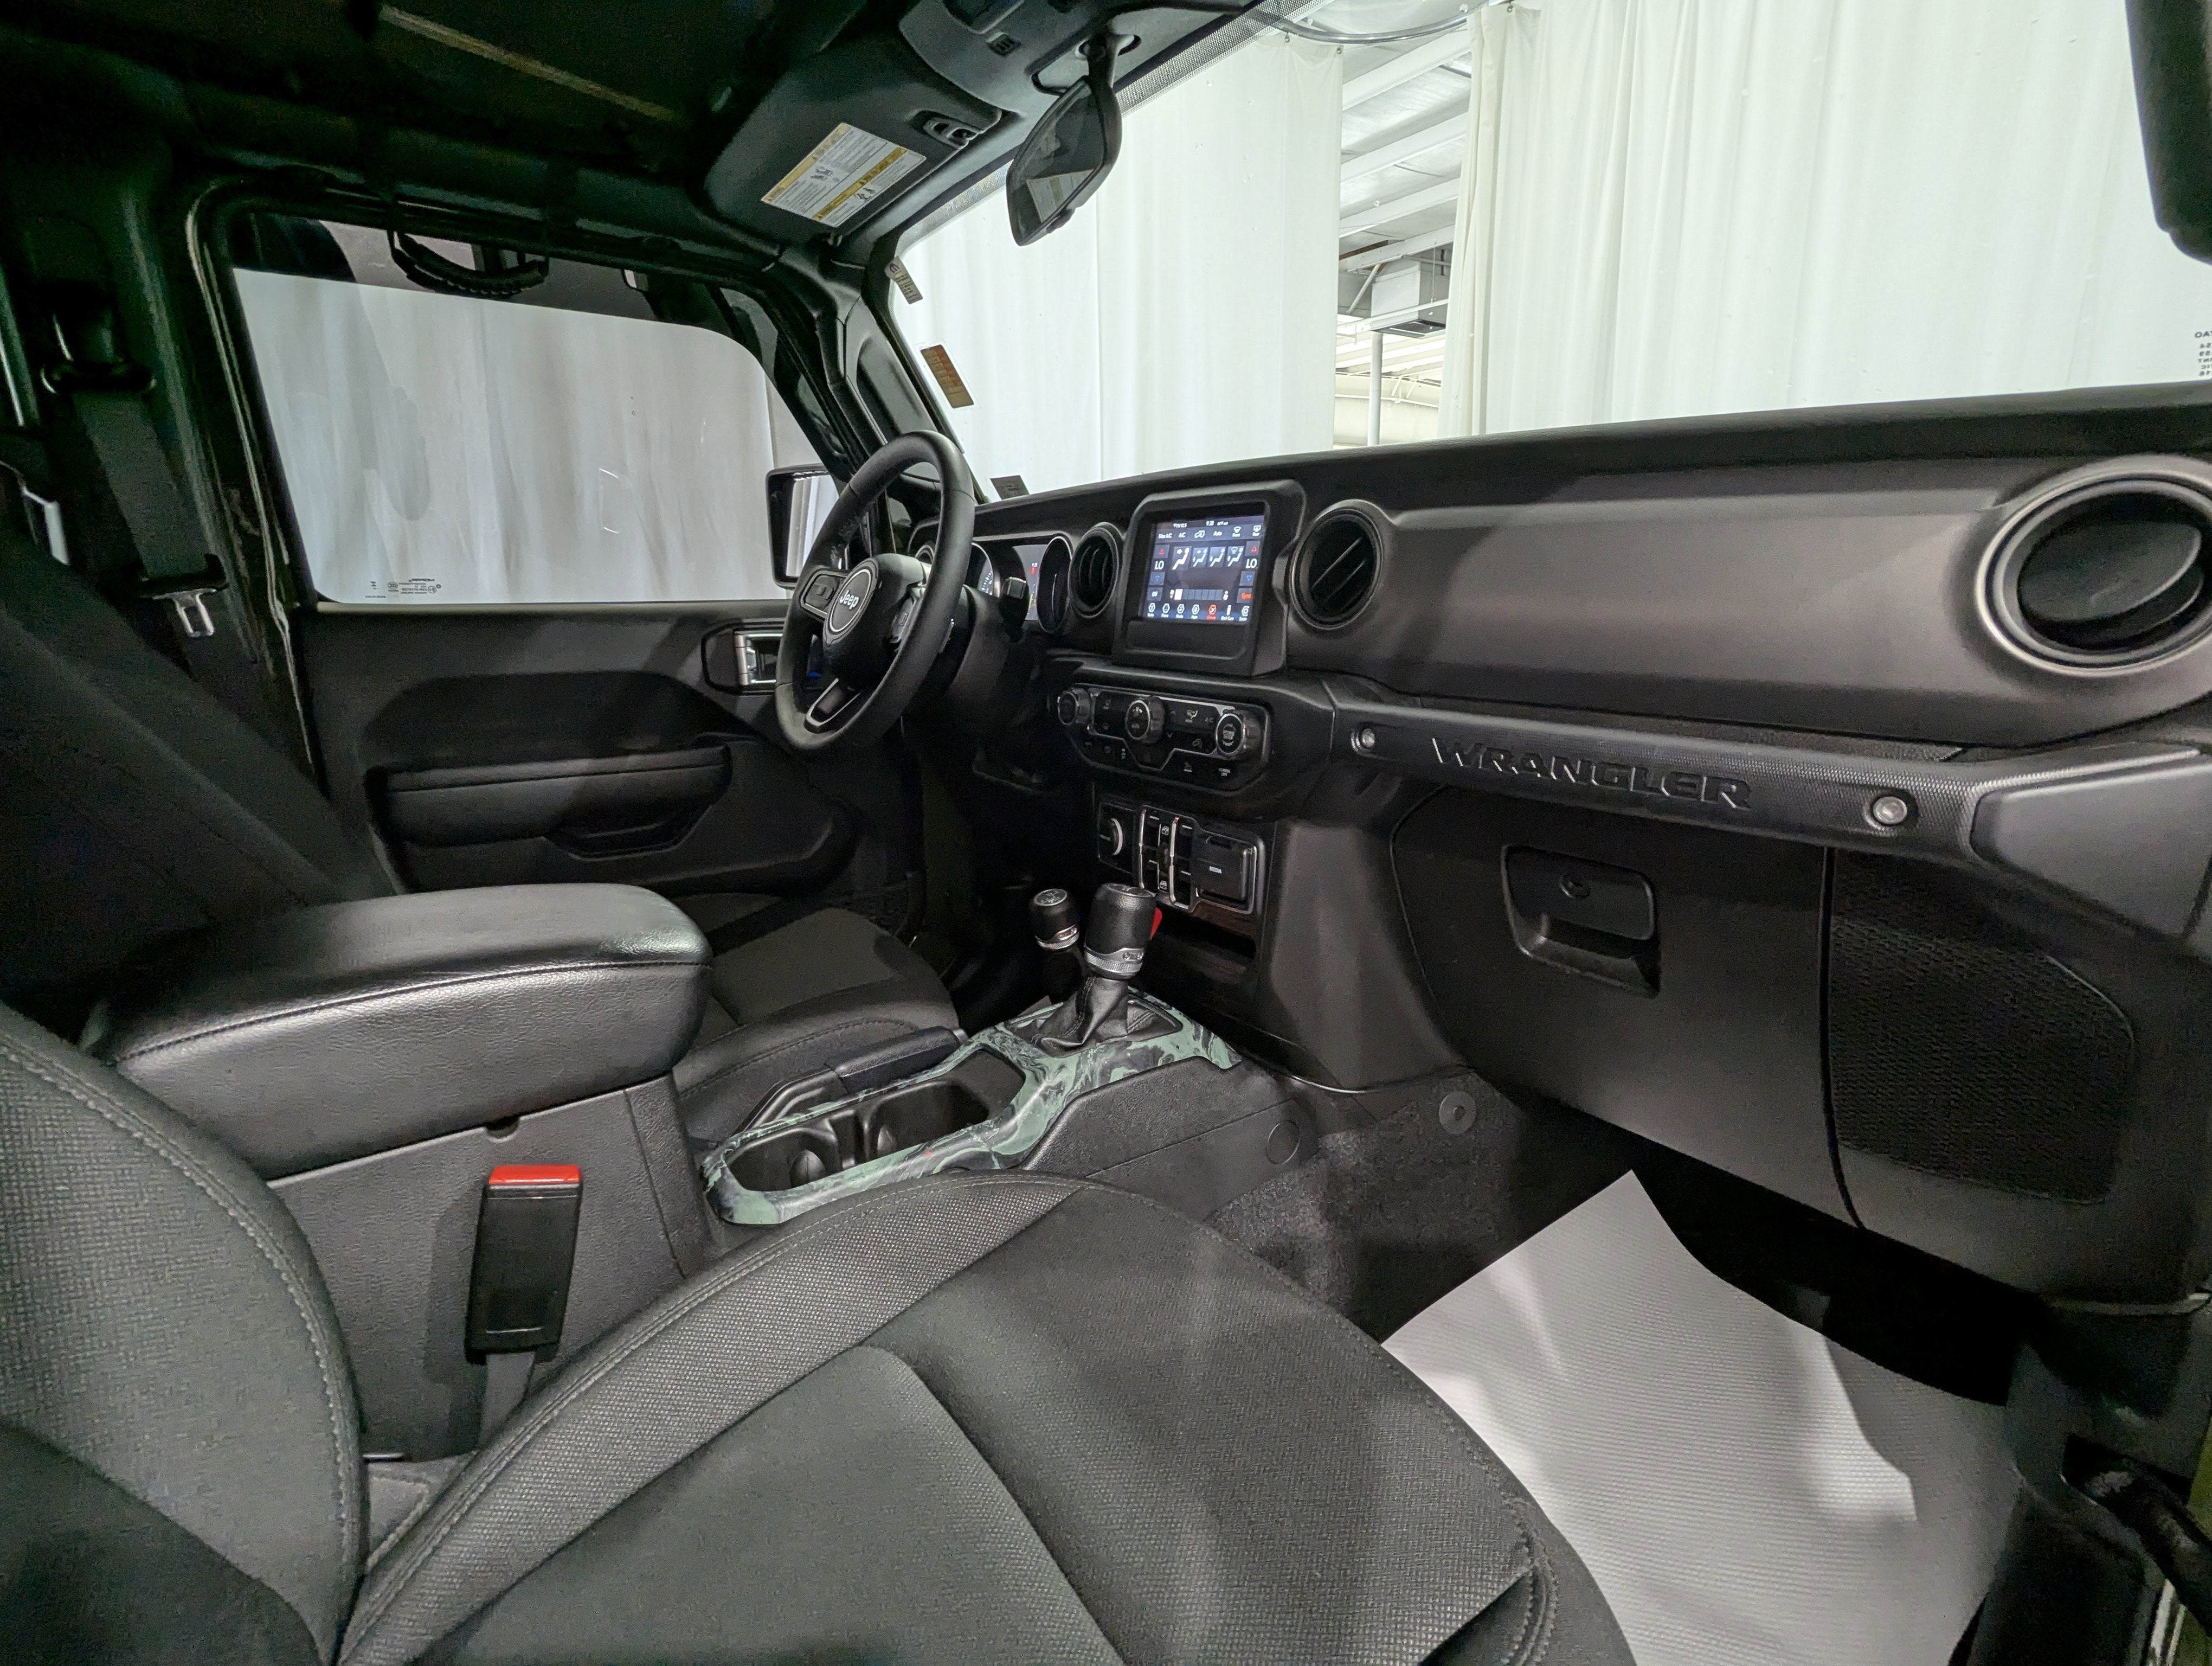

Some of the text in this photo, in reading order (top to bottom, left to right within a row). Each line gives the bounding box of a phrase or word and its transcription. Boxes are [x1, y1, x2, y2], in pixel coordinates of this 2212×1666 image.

[1154, 560, 1165, 570] LO
[1246, 558, 1258, 569] LO
[840, 589, 859, 609] Jeep
[1431, 737, 1752, 812] WRANGLER
